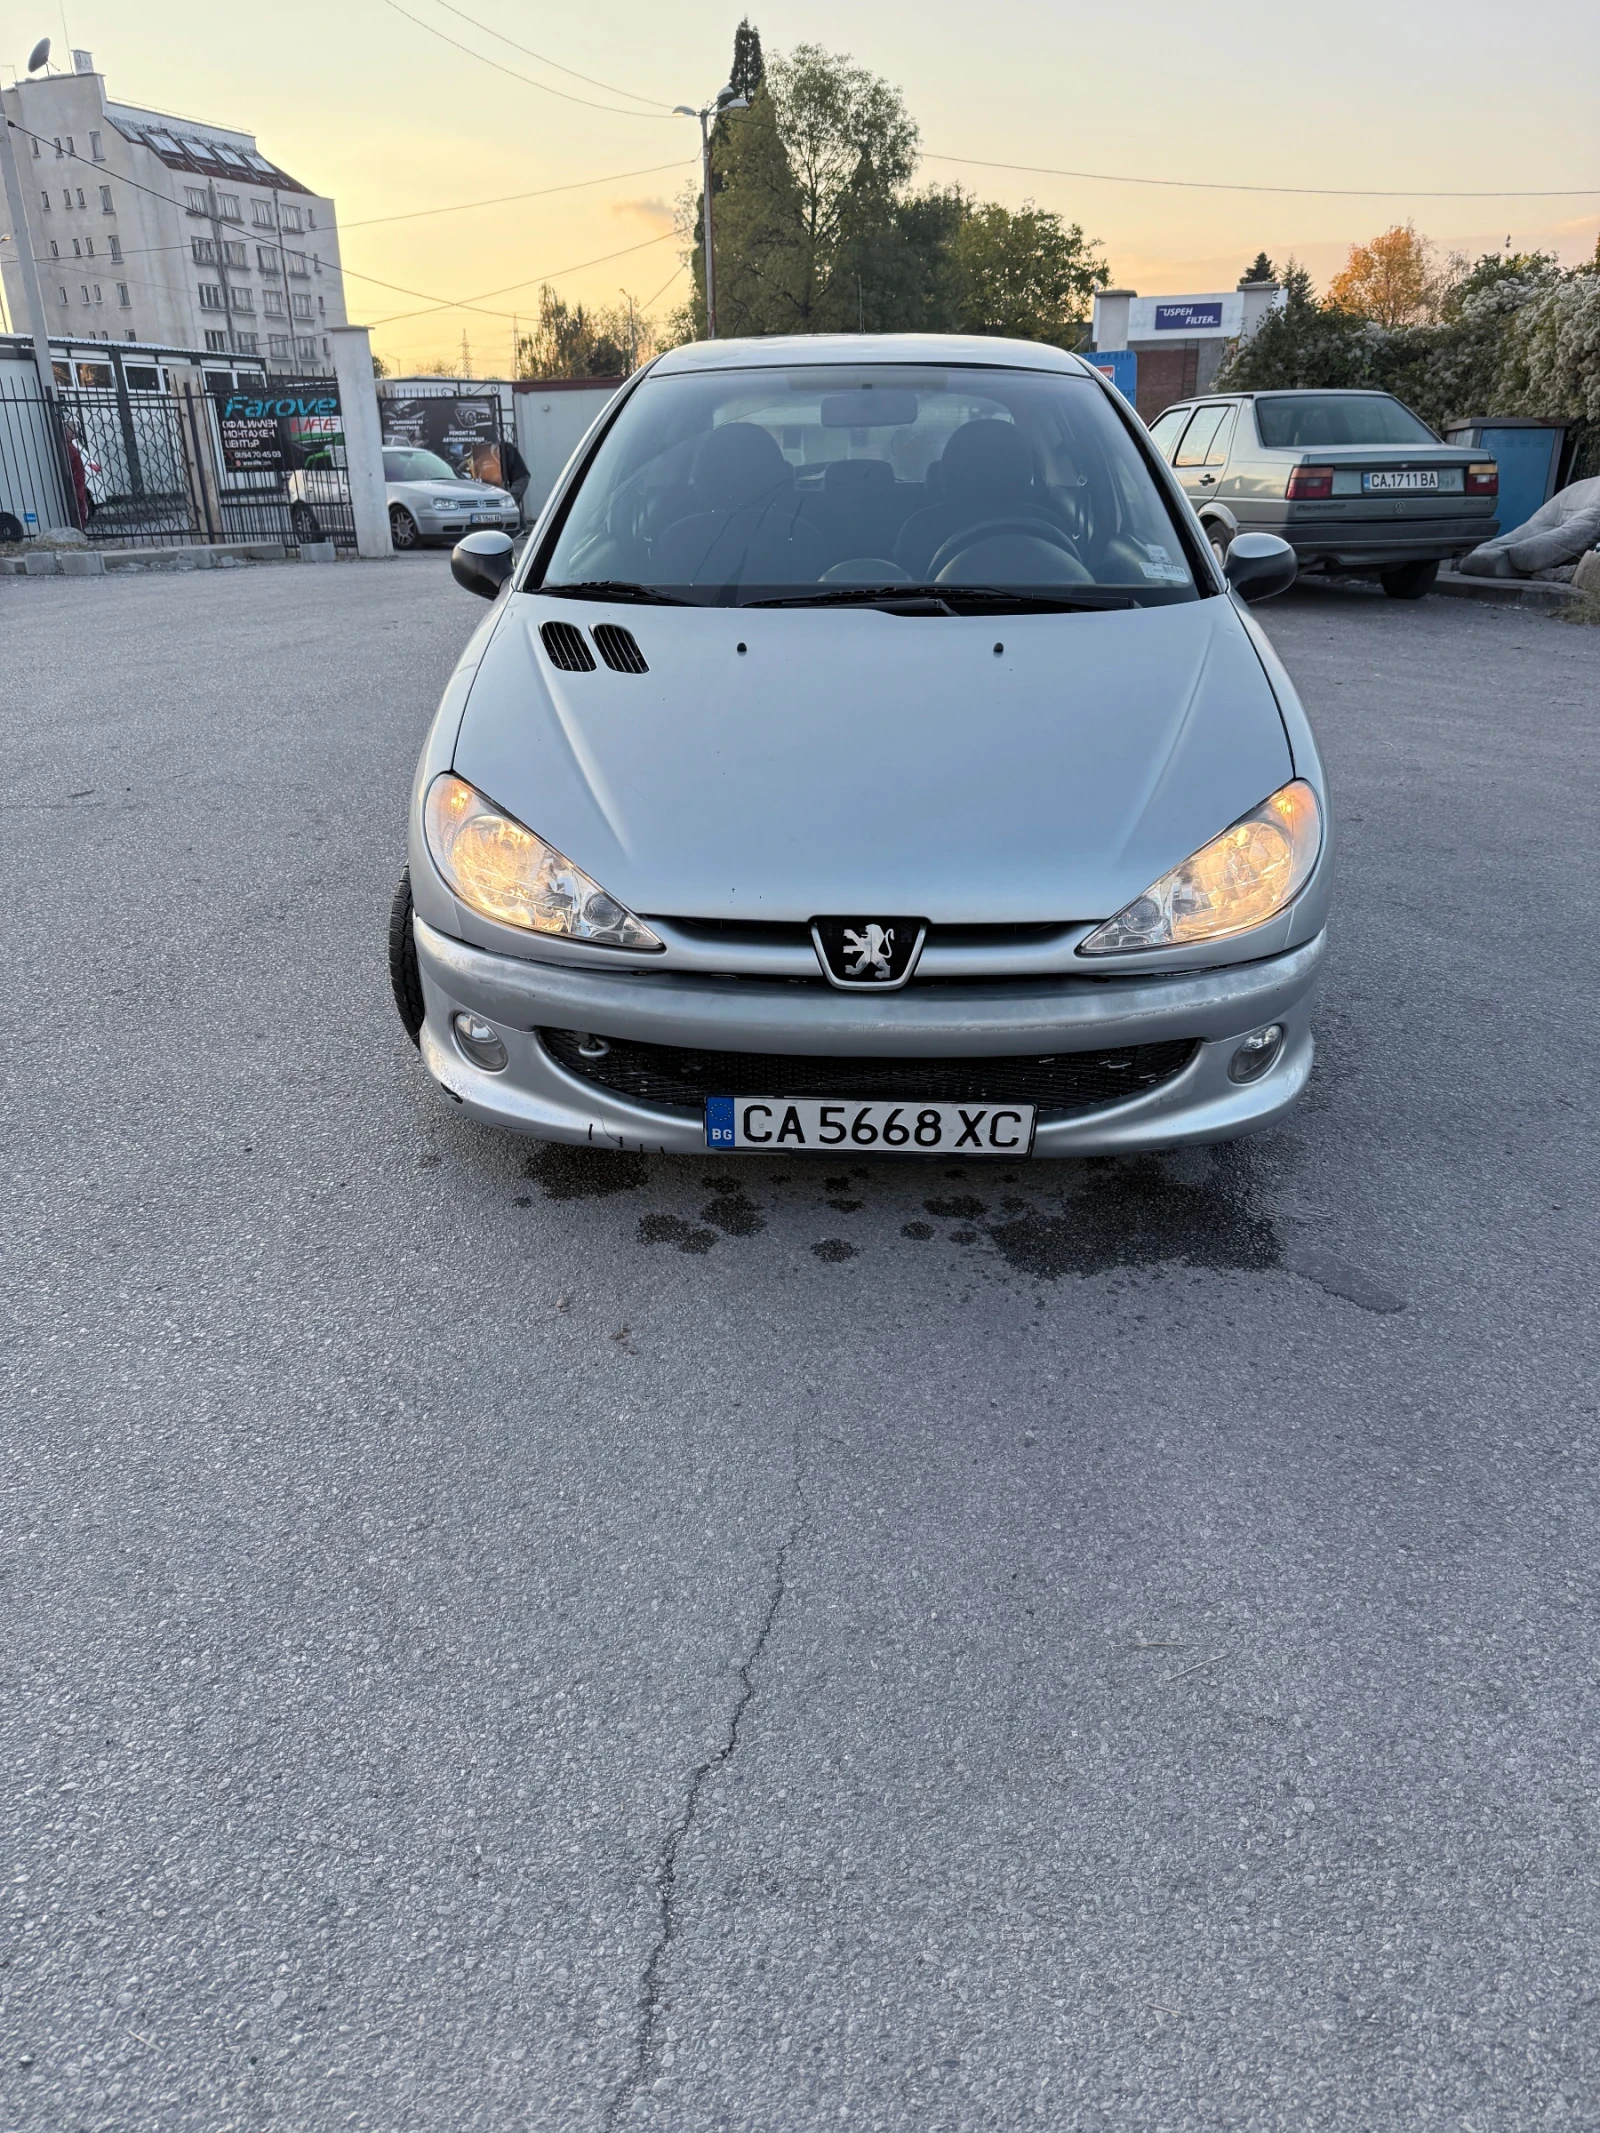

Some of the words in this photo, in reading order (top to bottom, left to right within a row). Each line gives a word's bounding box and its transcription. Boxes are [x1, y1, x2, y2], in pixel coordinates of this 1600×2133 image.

[1160, 307, 1193, 316] USPEH
[1185, 316, 1218, 325] FILTER
[224, 396, 337, 418] Farove
[290, 418, 339, 432] LIFE
[743, 1104, 806, 1144] CA
[819, 1106, 942, 1147] 5668
[954, 1109, 1022, 1148] XC
[711, 1128, 732, 1140] BG
